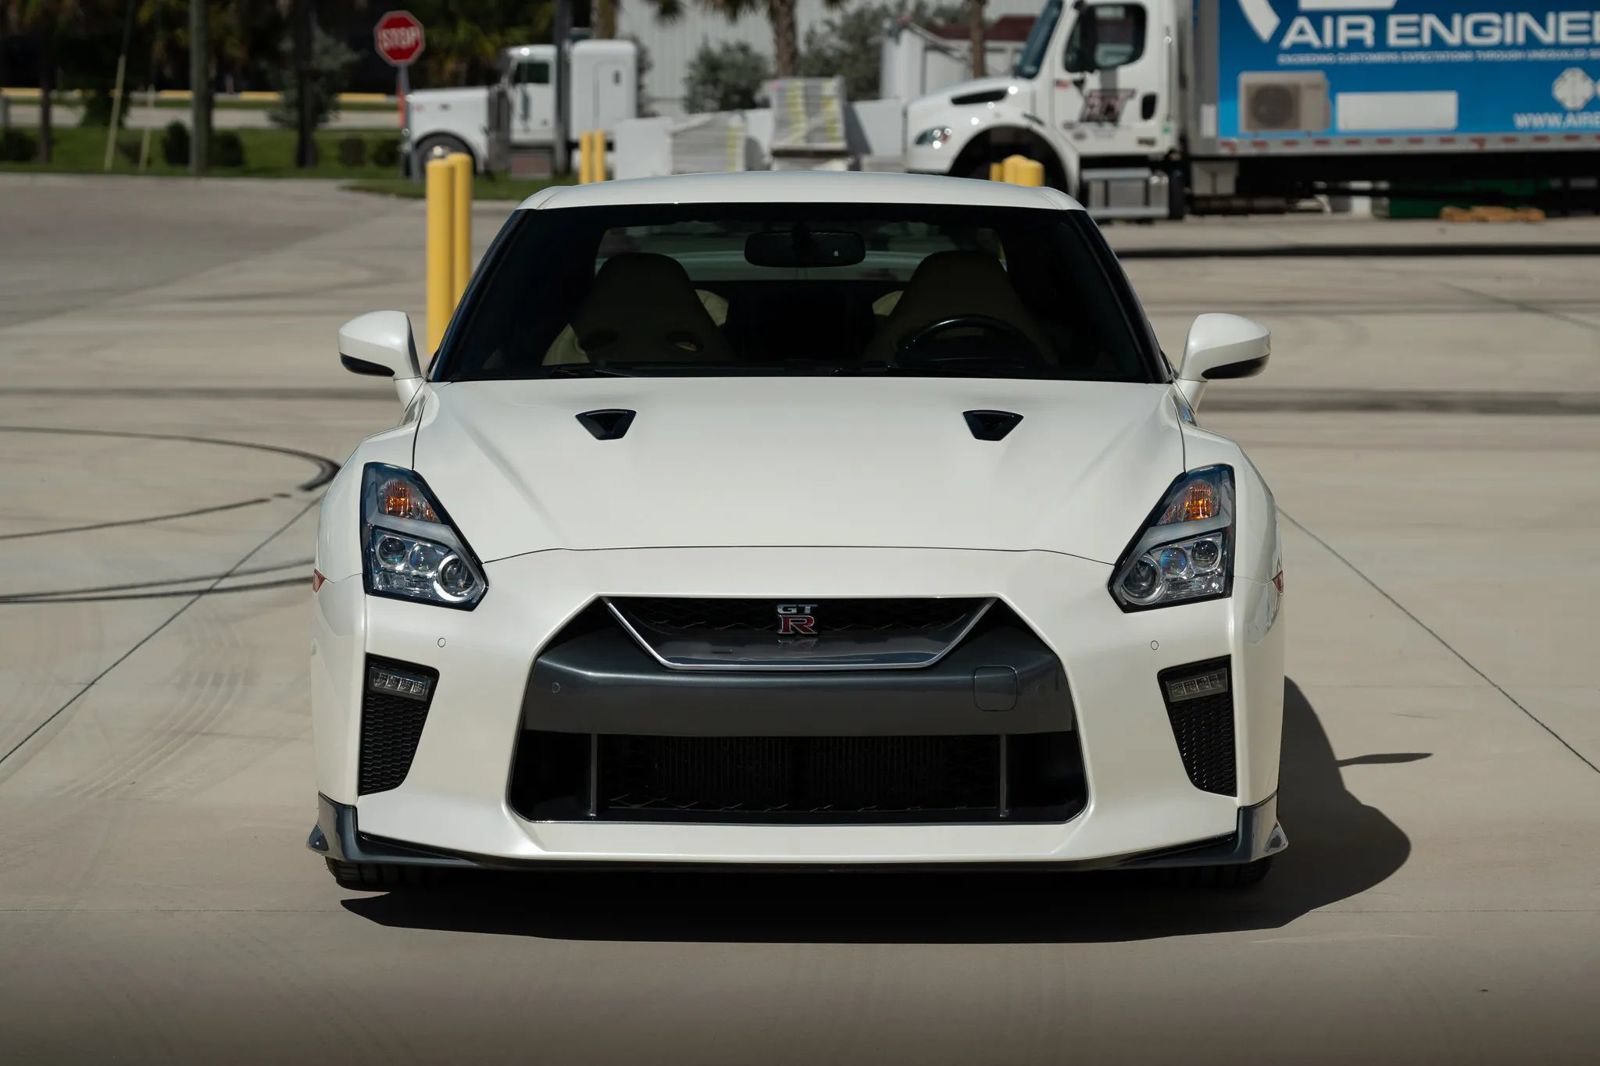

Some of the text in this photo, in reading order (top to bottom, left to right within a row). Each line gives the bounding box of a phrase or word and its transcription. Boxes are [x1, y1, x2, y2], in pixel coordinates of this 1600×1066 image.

[381, 26, 417, 49] STOP
[1280, 11, 1600, 48] AIR ENGINE
[777, 604, 818, 614] GT
[777, 614, 818, 635] R
